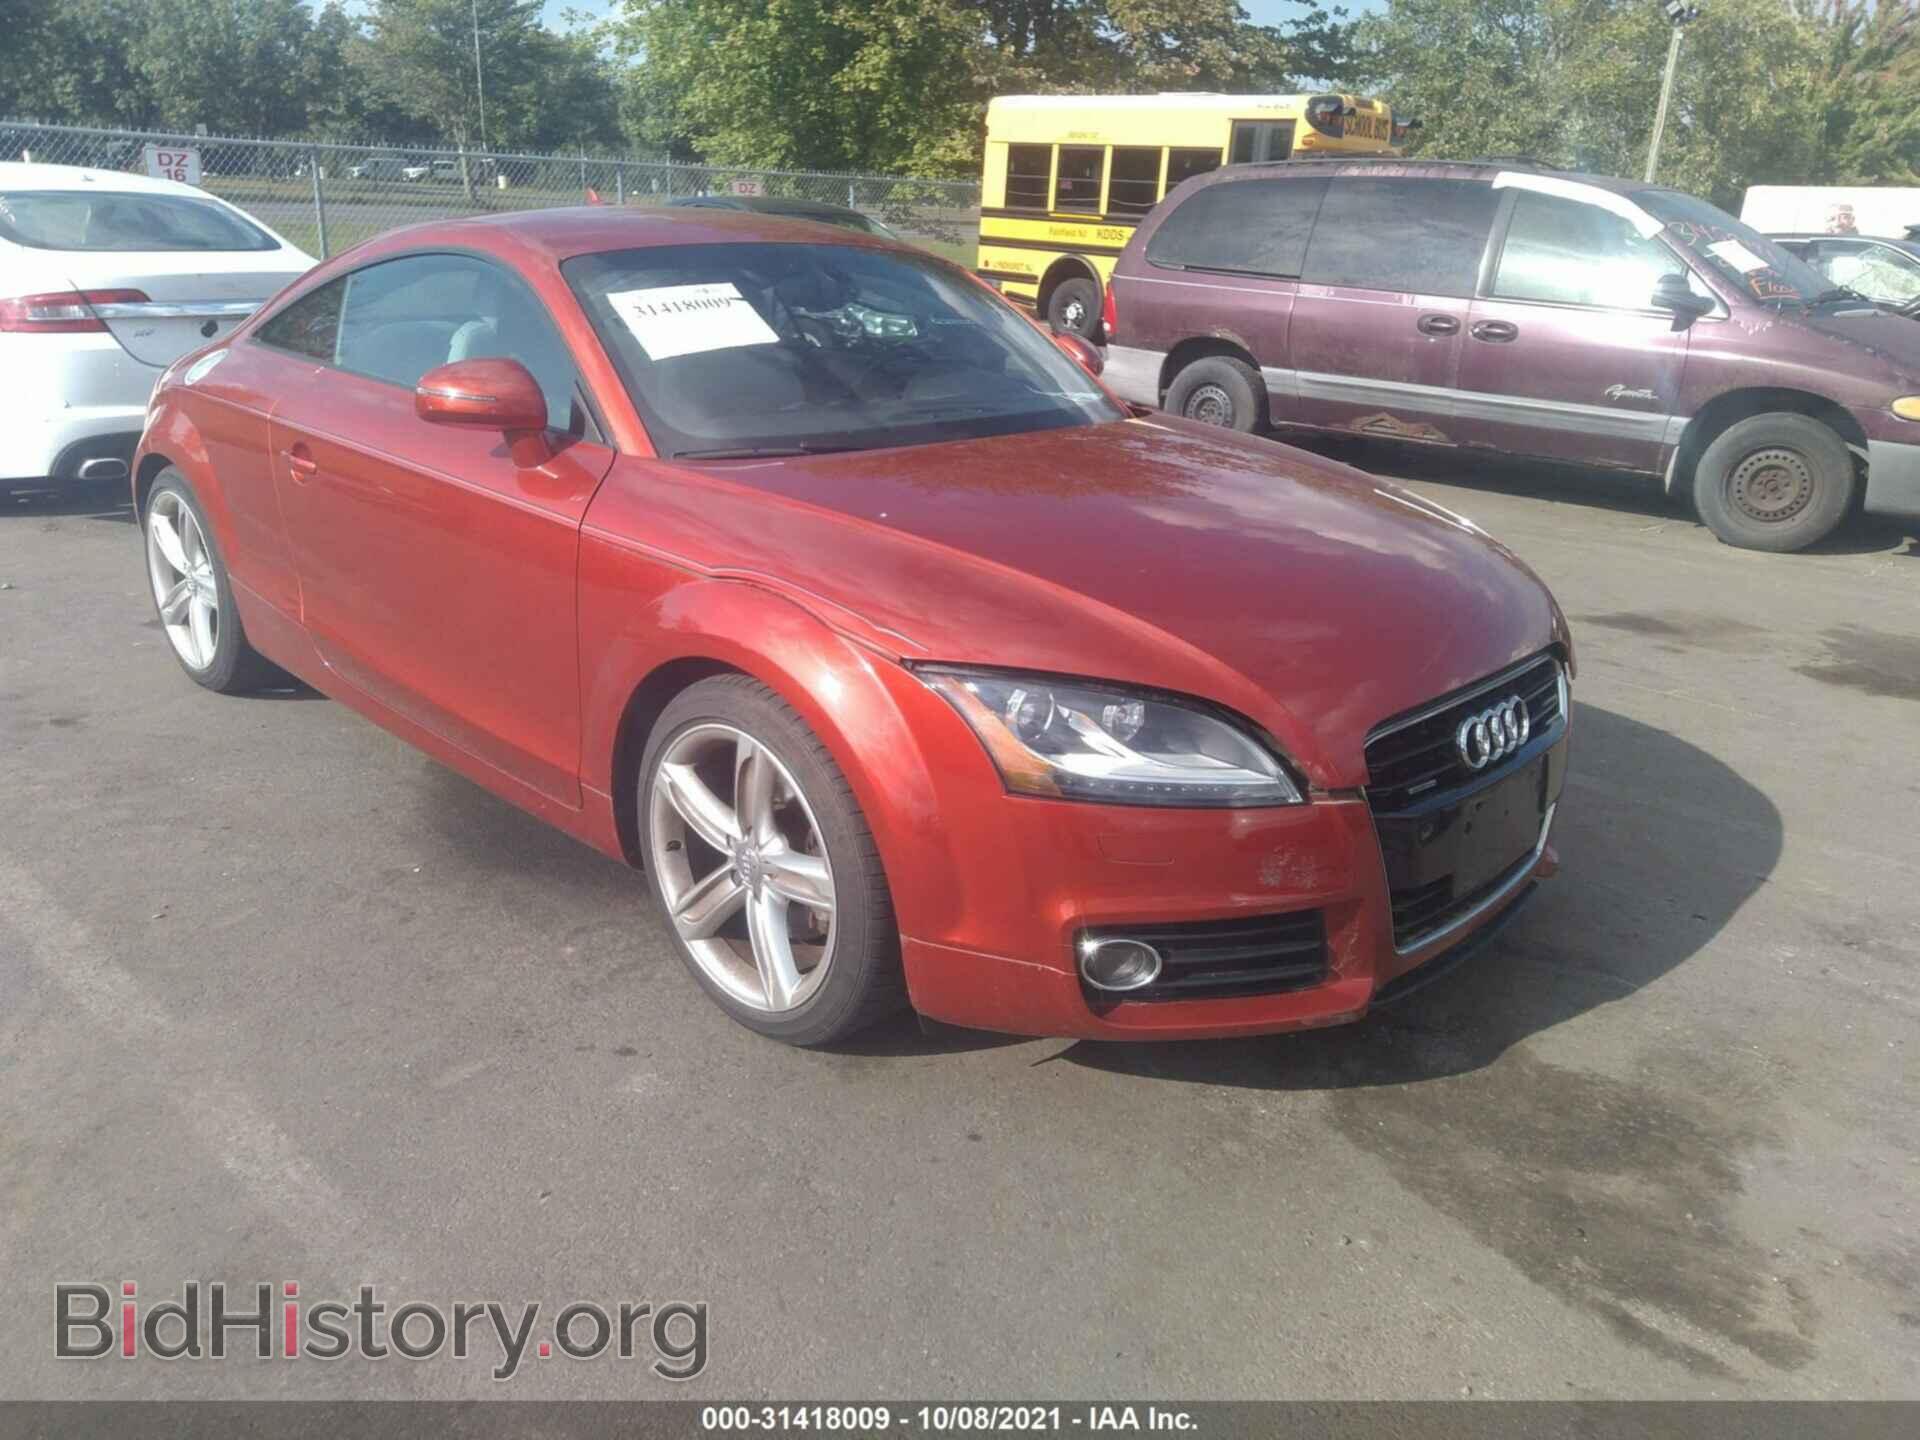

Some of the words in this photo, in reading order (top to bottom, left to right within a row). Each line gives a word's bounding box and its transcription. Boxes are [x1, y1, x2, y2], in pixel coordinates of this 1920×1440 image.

[157, 152, 189, 167] DZ
[162, 168, 186, 182] 16
[739, 183, 757, 194] DZ
